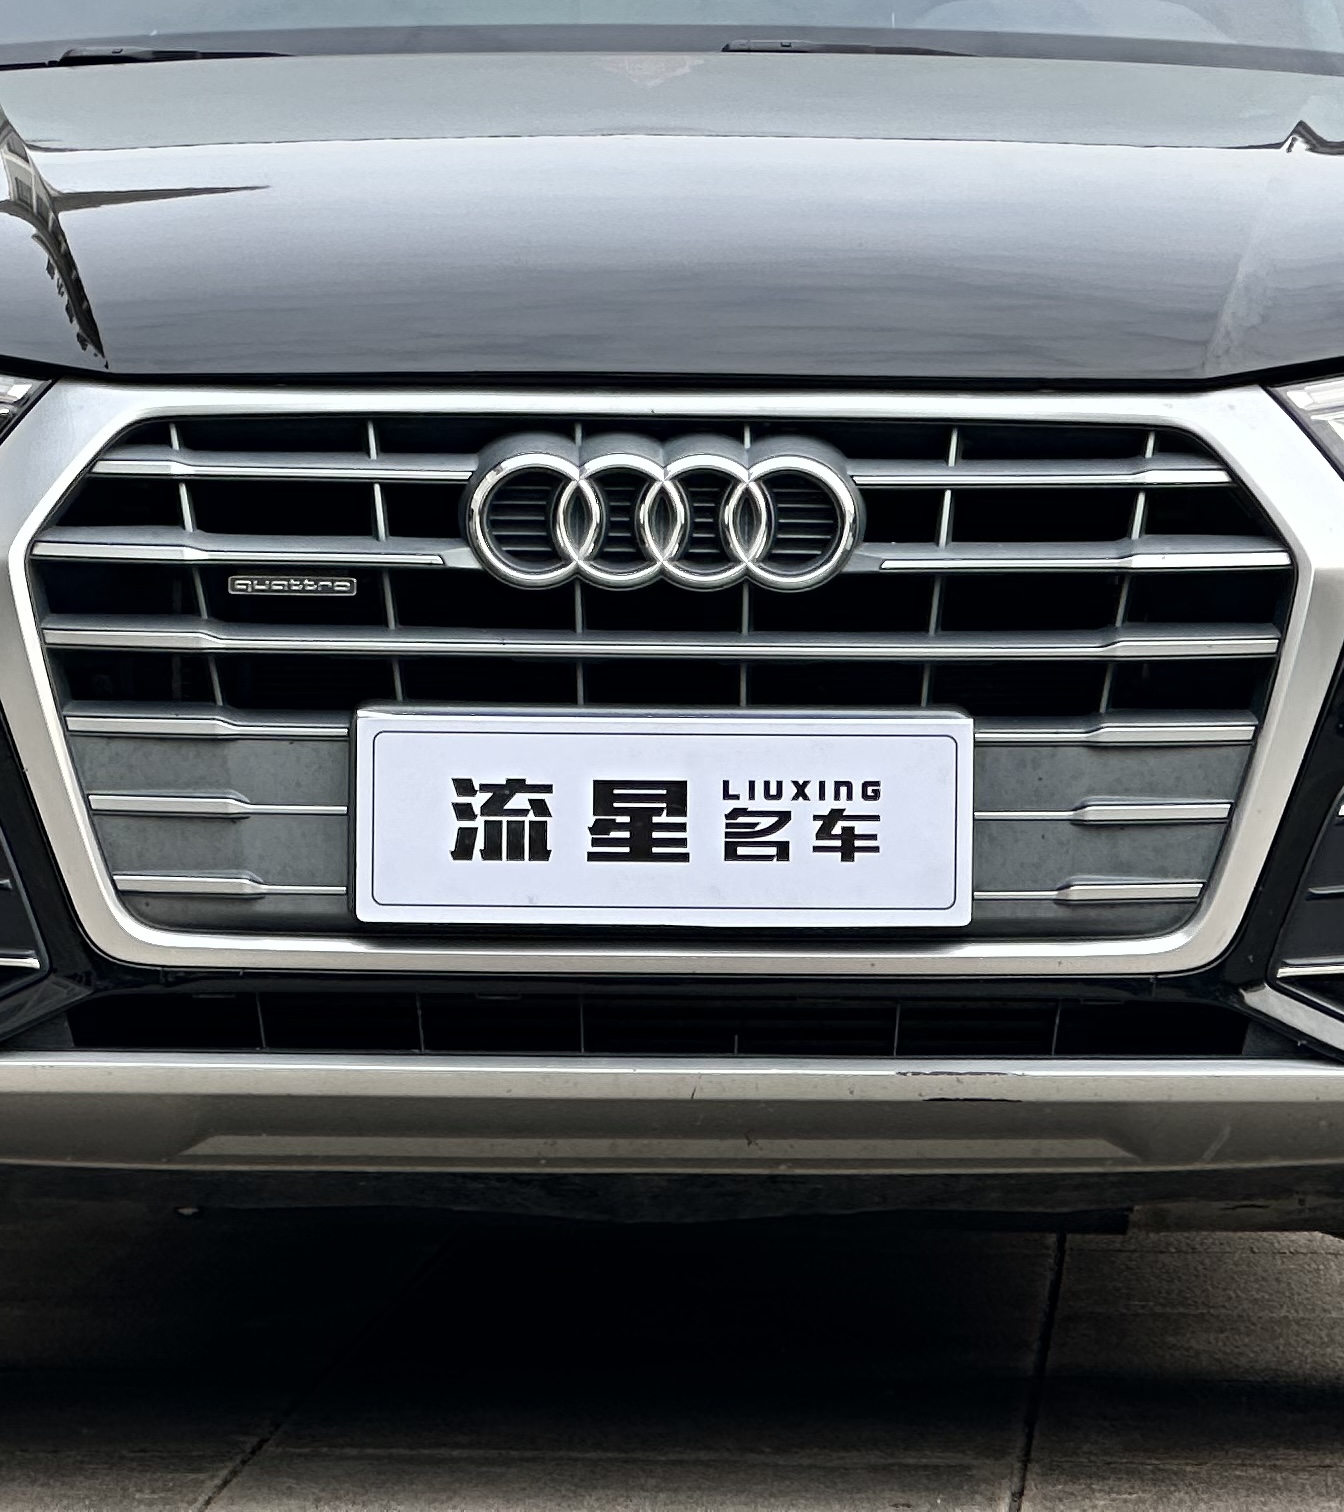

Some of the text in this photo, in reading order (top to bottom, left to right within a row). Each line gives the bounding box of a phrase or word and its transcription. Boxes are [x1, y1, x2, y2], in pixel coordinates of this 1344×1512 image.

[234, 579, 350, 592] quattro
[722, 779, 881, 802] LIUXING
[449, 777, 690, 863] 流星
[723, 807, 881, 863] 名车
